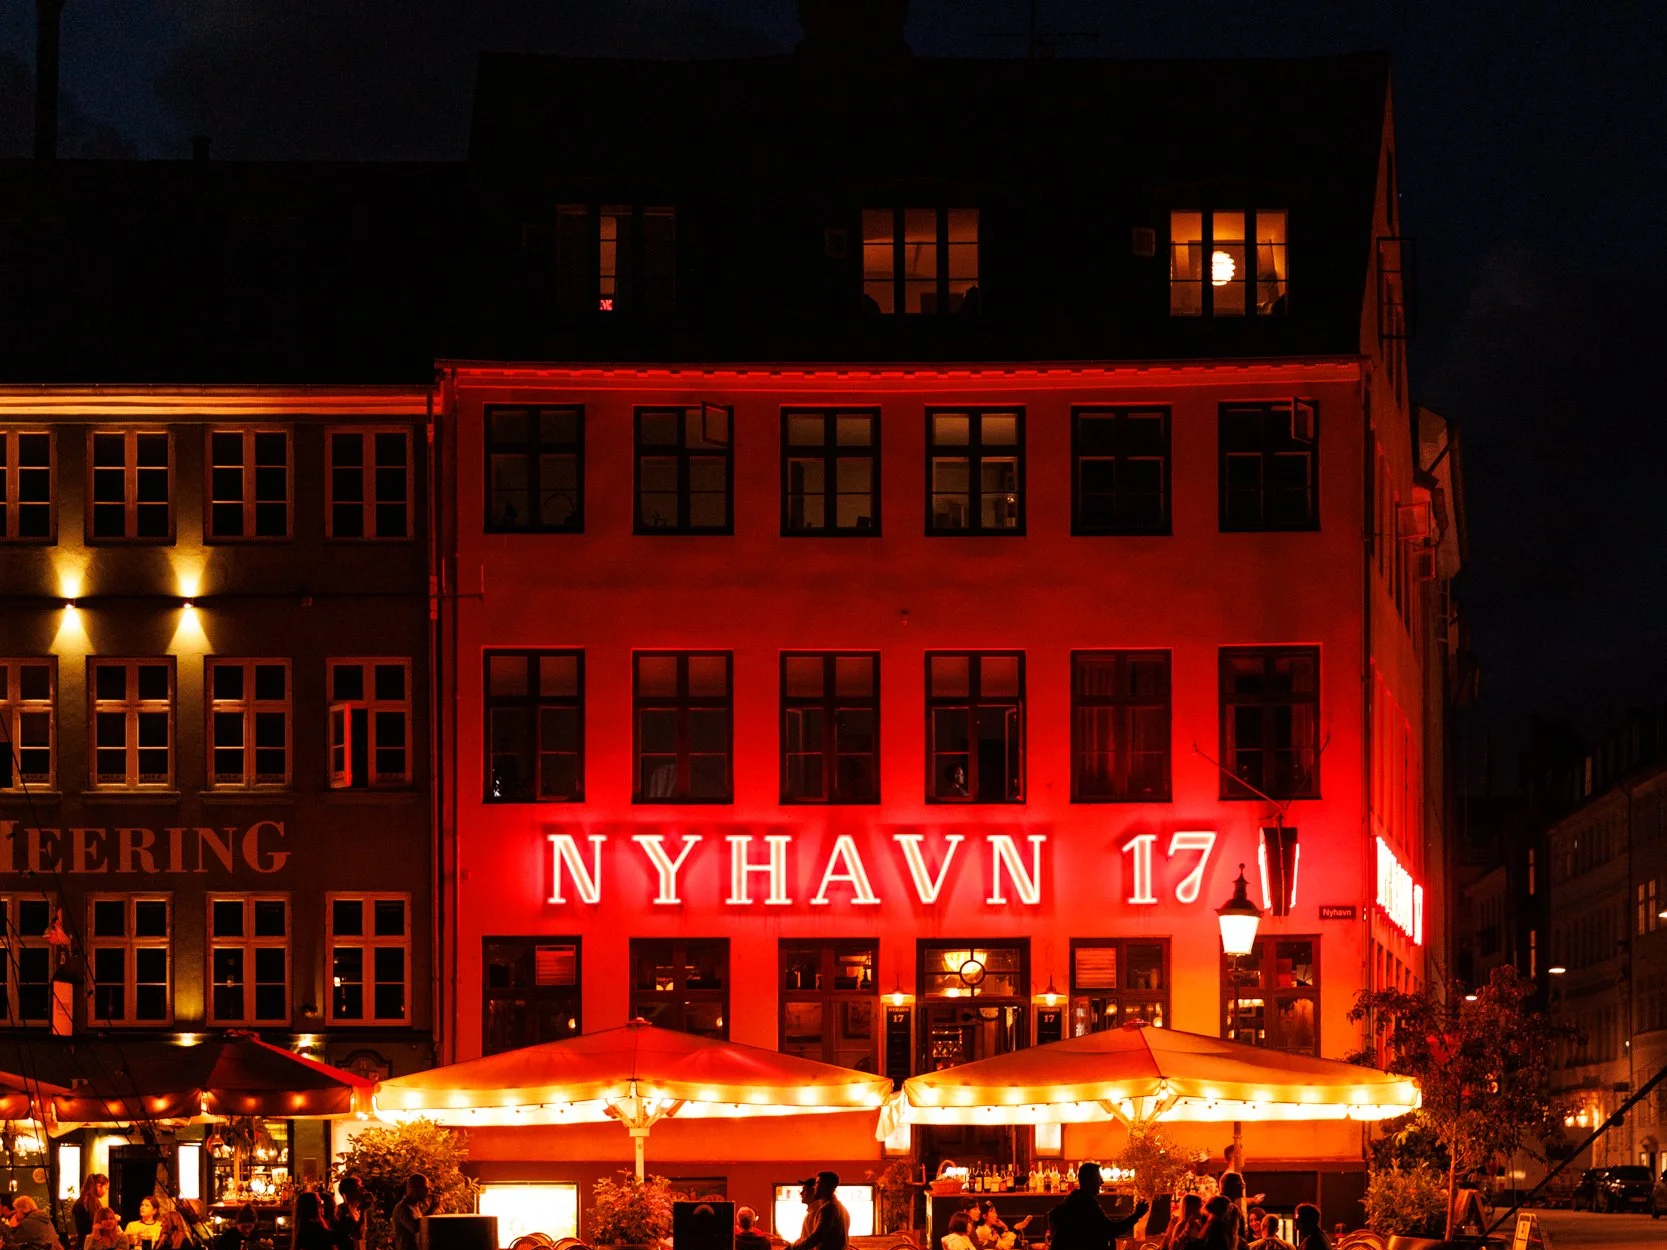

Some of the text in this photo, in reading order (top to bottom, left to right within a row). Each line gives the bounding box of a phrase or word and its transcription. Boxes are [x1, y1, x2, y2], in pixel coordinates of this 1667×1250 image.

[546, 829, 1219, 907] NYHAVN 17
[1322, 908, 1352, 918] Nyhavn
[892, 1014, 905, 1023] 17
[1043, 1014, 1055, 1023] 17
